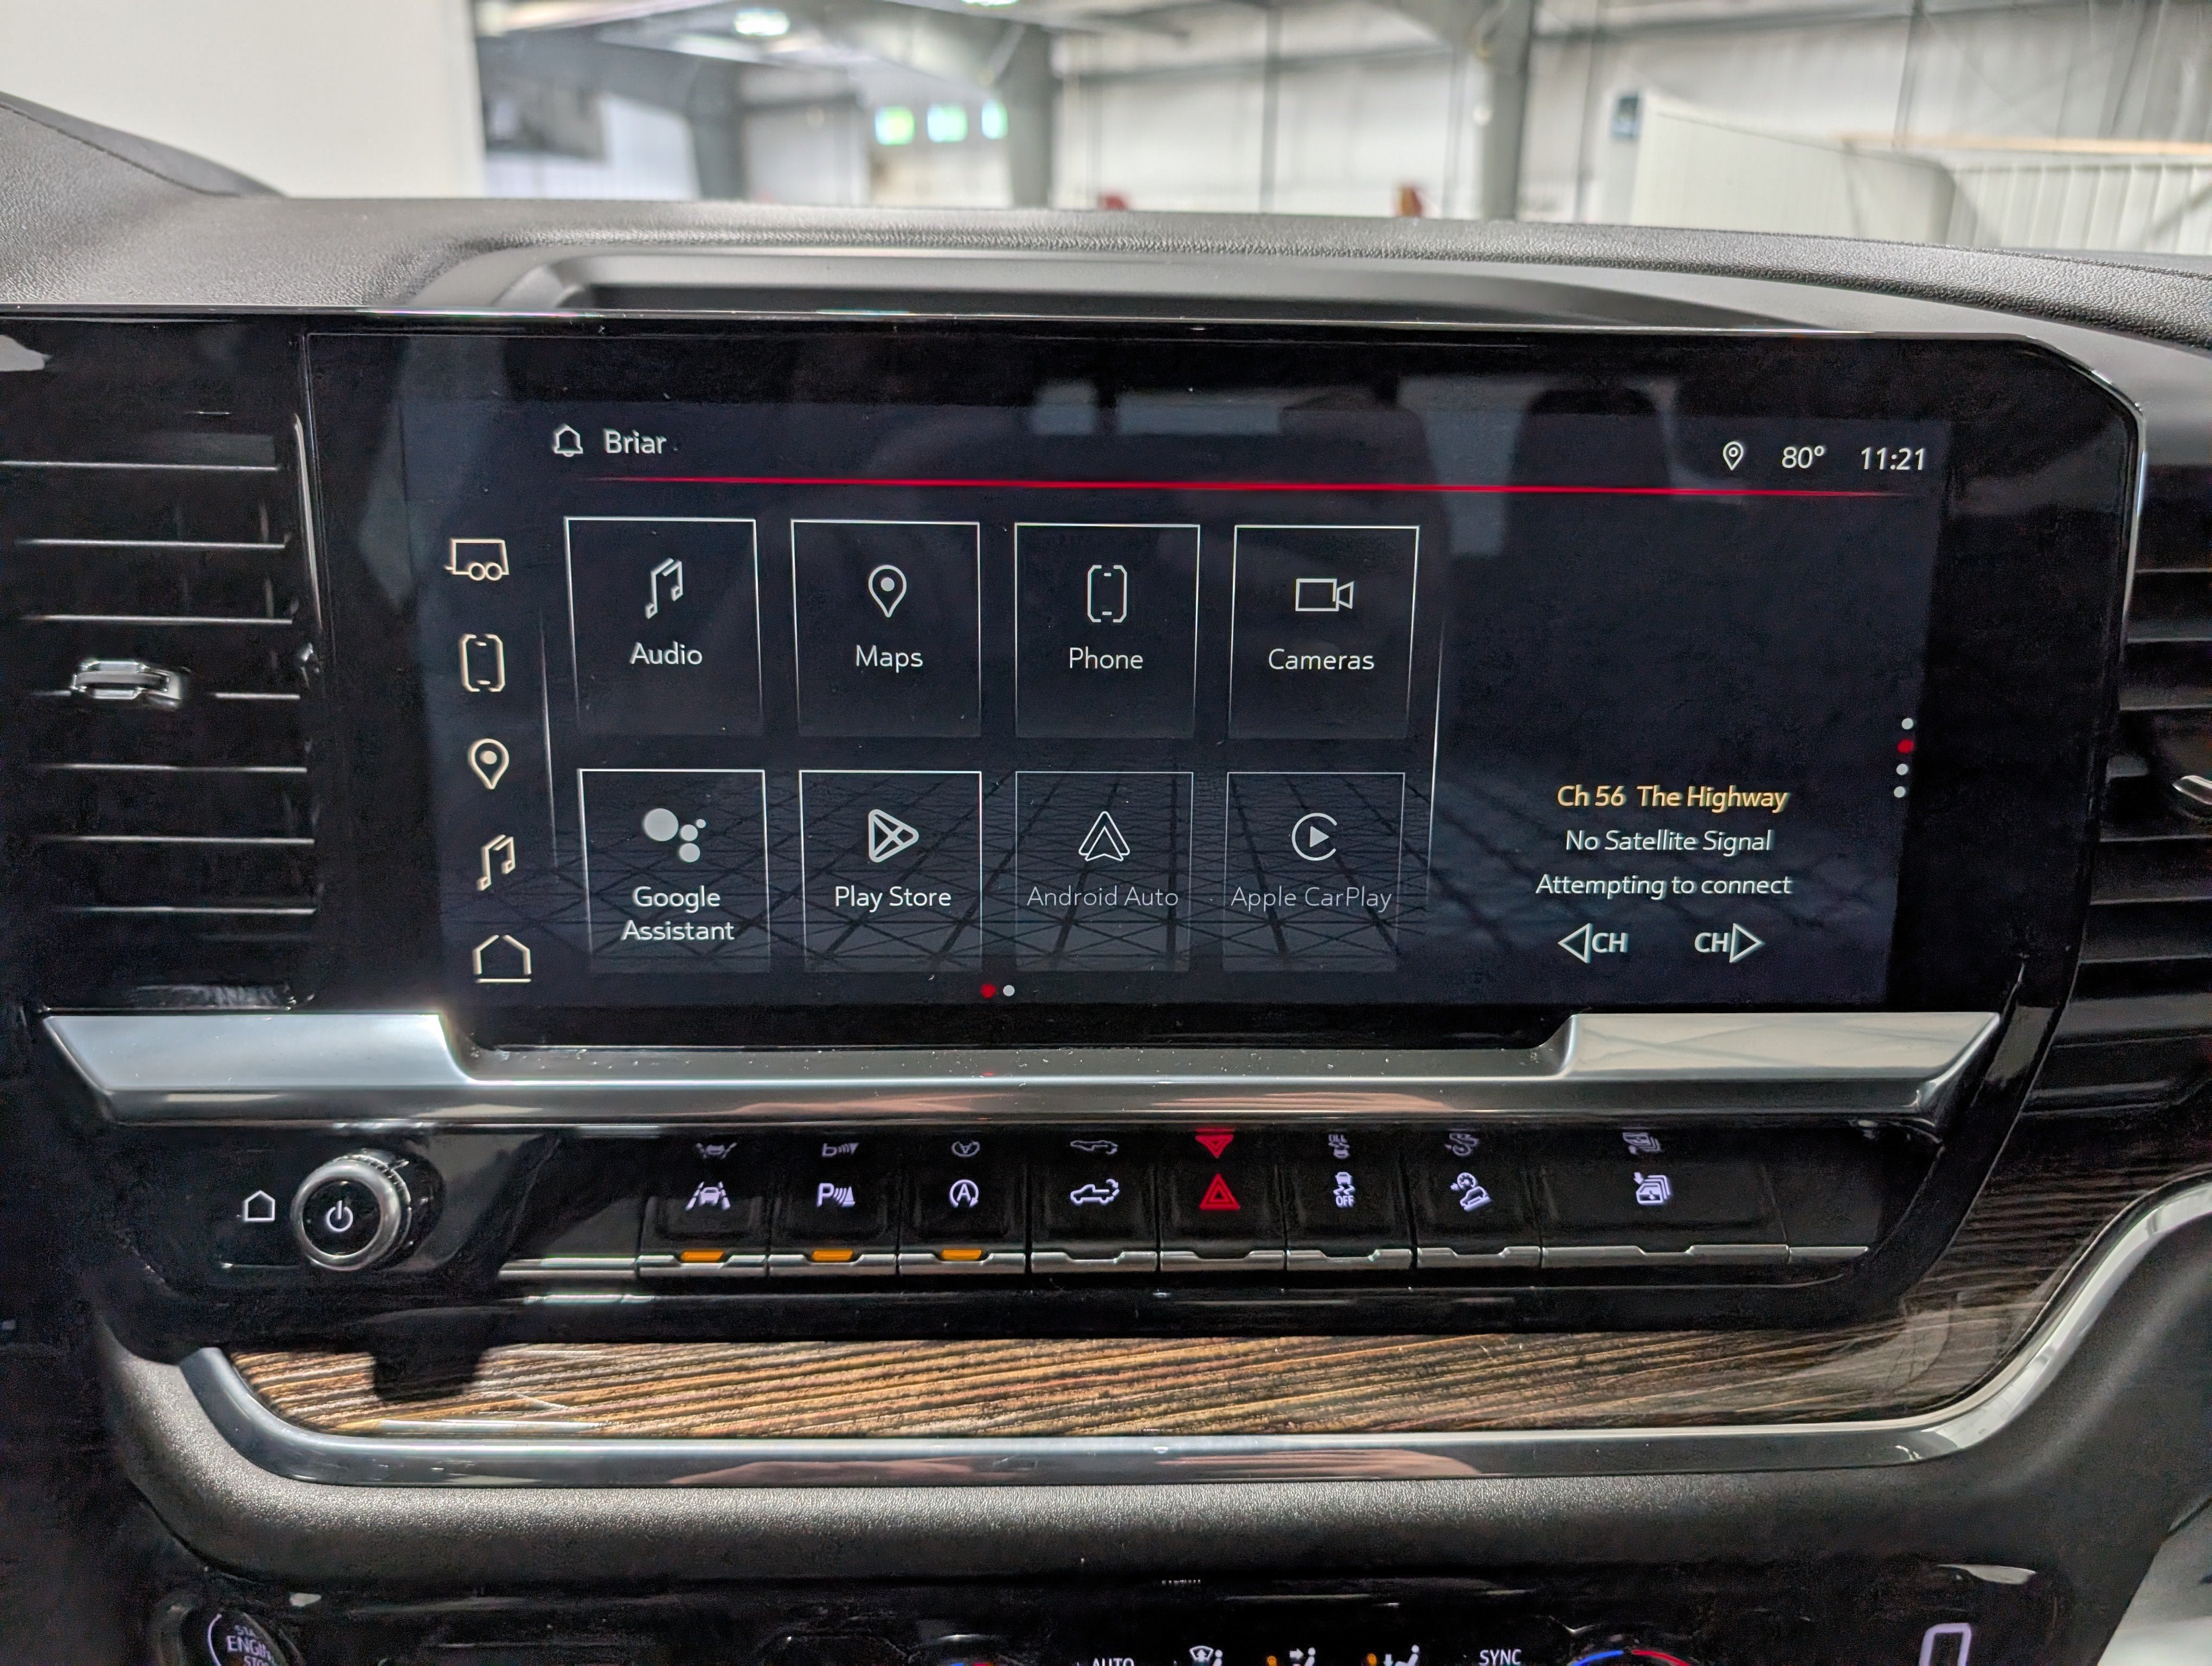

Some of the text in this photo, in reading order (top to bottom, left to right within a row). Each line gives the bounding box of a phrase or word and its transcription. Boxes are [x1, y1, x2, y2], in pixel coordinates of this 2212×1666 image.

[603, 429, 667, 454] Briar
[1861, 446, 1926, 471] 11:21
[629, 640, 703, 665] Audio
[856, 644, 924, 673] Maps
[1069, 645, 1144, 669] Phone
[1268, 648, 1375, 670] Cameras
[1557, 784, 1790, 813] Ch 56 The Highway
[1565, 828, 1774, 857] No Satellite Signal
[632, 884, 721, 914] Google
[834, 884, 953, 913] Play Store
[1026, 885, 1179, 907] Android Auto
[1535, 873, 1794, 900] Attempting to connect
[1230, 885, 1393, 914] Apple CarPlay
[621, 920, 735, 941] Assistant
[1591, 932, 1629, 953] CH
[1694, 932, 1729, 953] CH
[1335, 1195, 1355, 1208] OFF
[1478, 1648, 1522, 1666] SYNC
